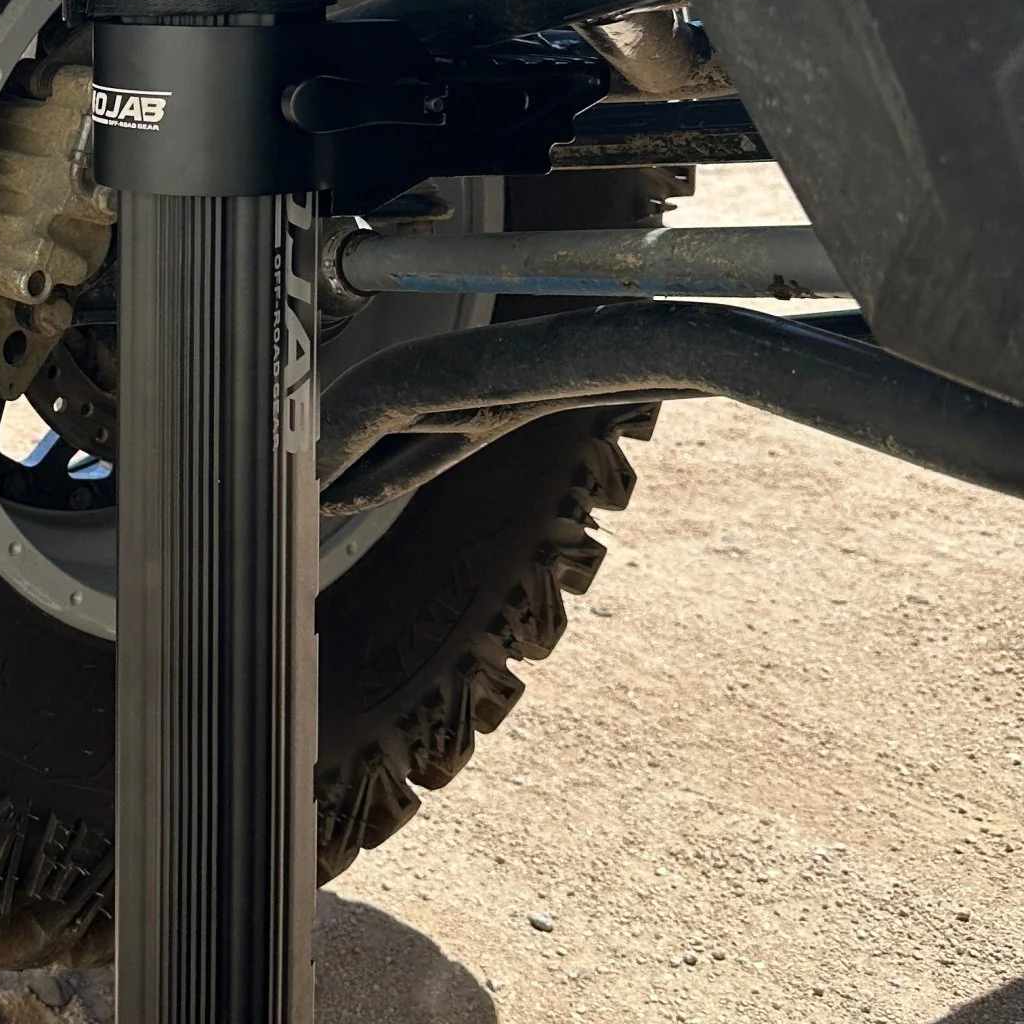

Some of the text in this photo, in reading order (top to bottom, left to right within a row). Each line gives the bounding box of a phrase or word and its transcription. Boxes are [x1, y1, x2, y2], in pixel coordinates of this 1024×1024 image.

[92, 90, 167, 123] OJAB
[272, 254, 281, 453] OFF-ROAD GEAR
